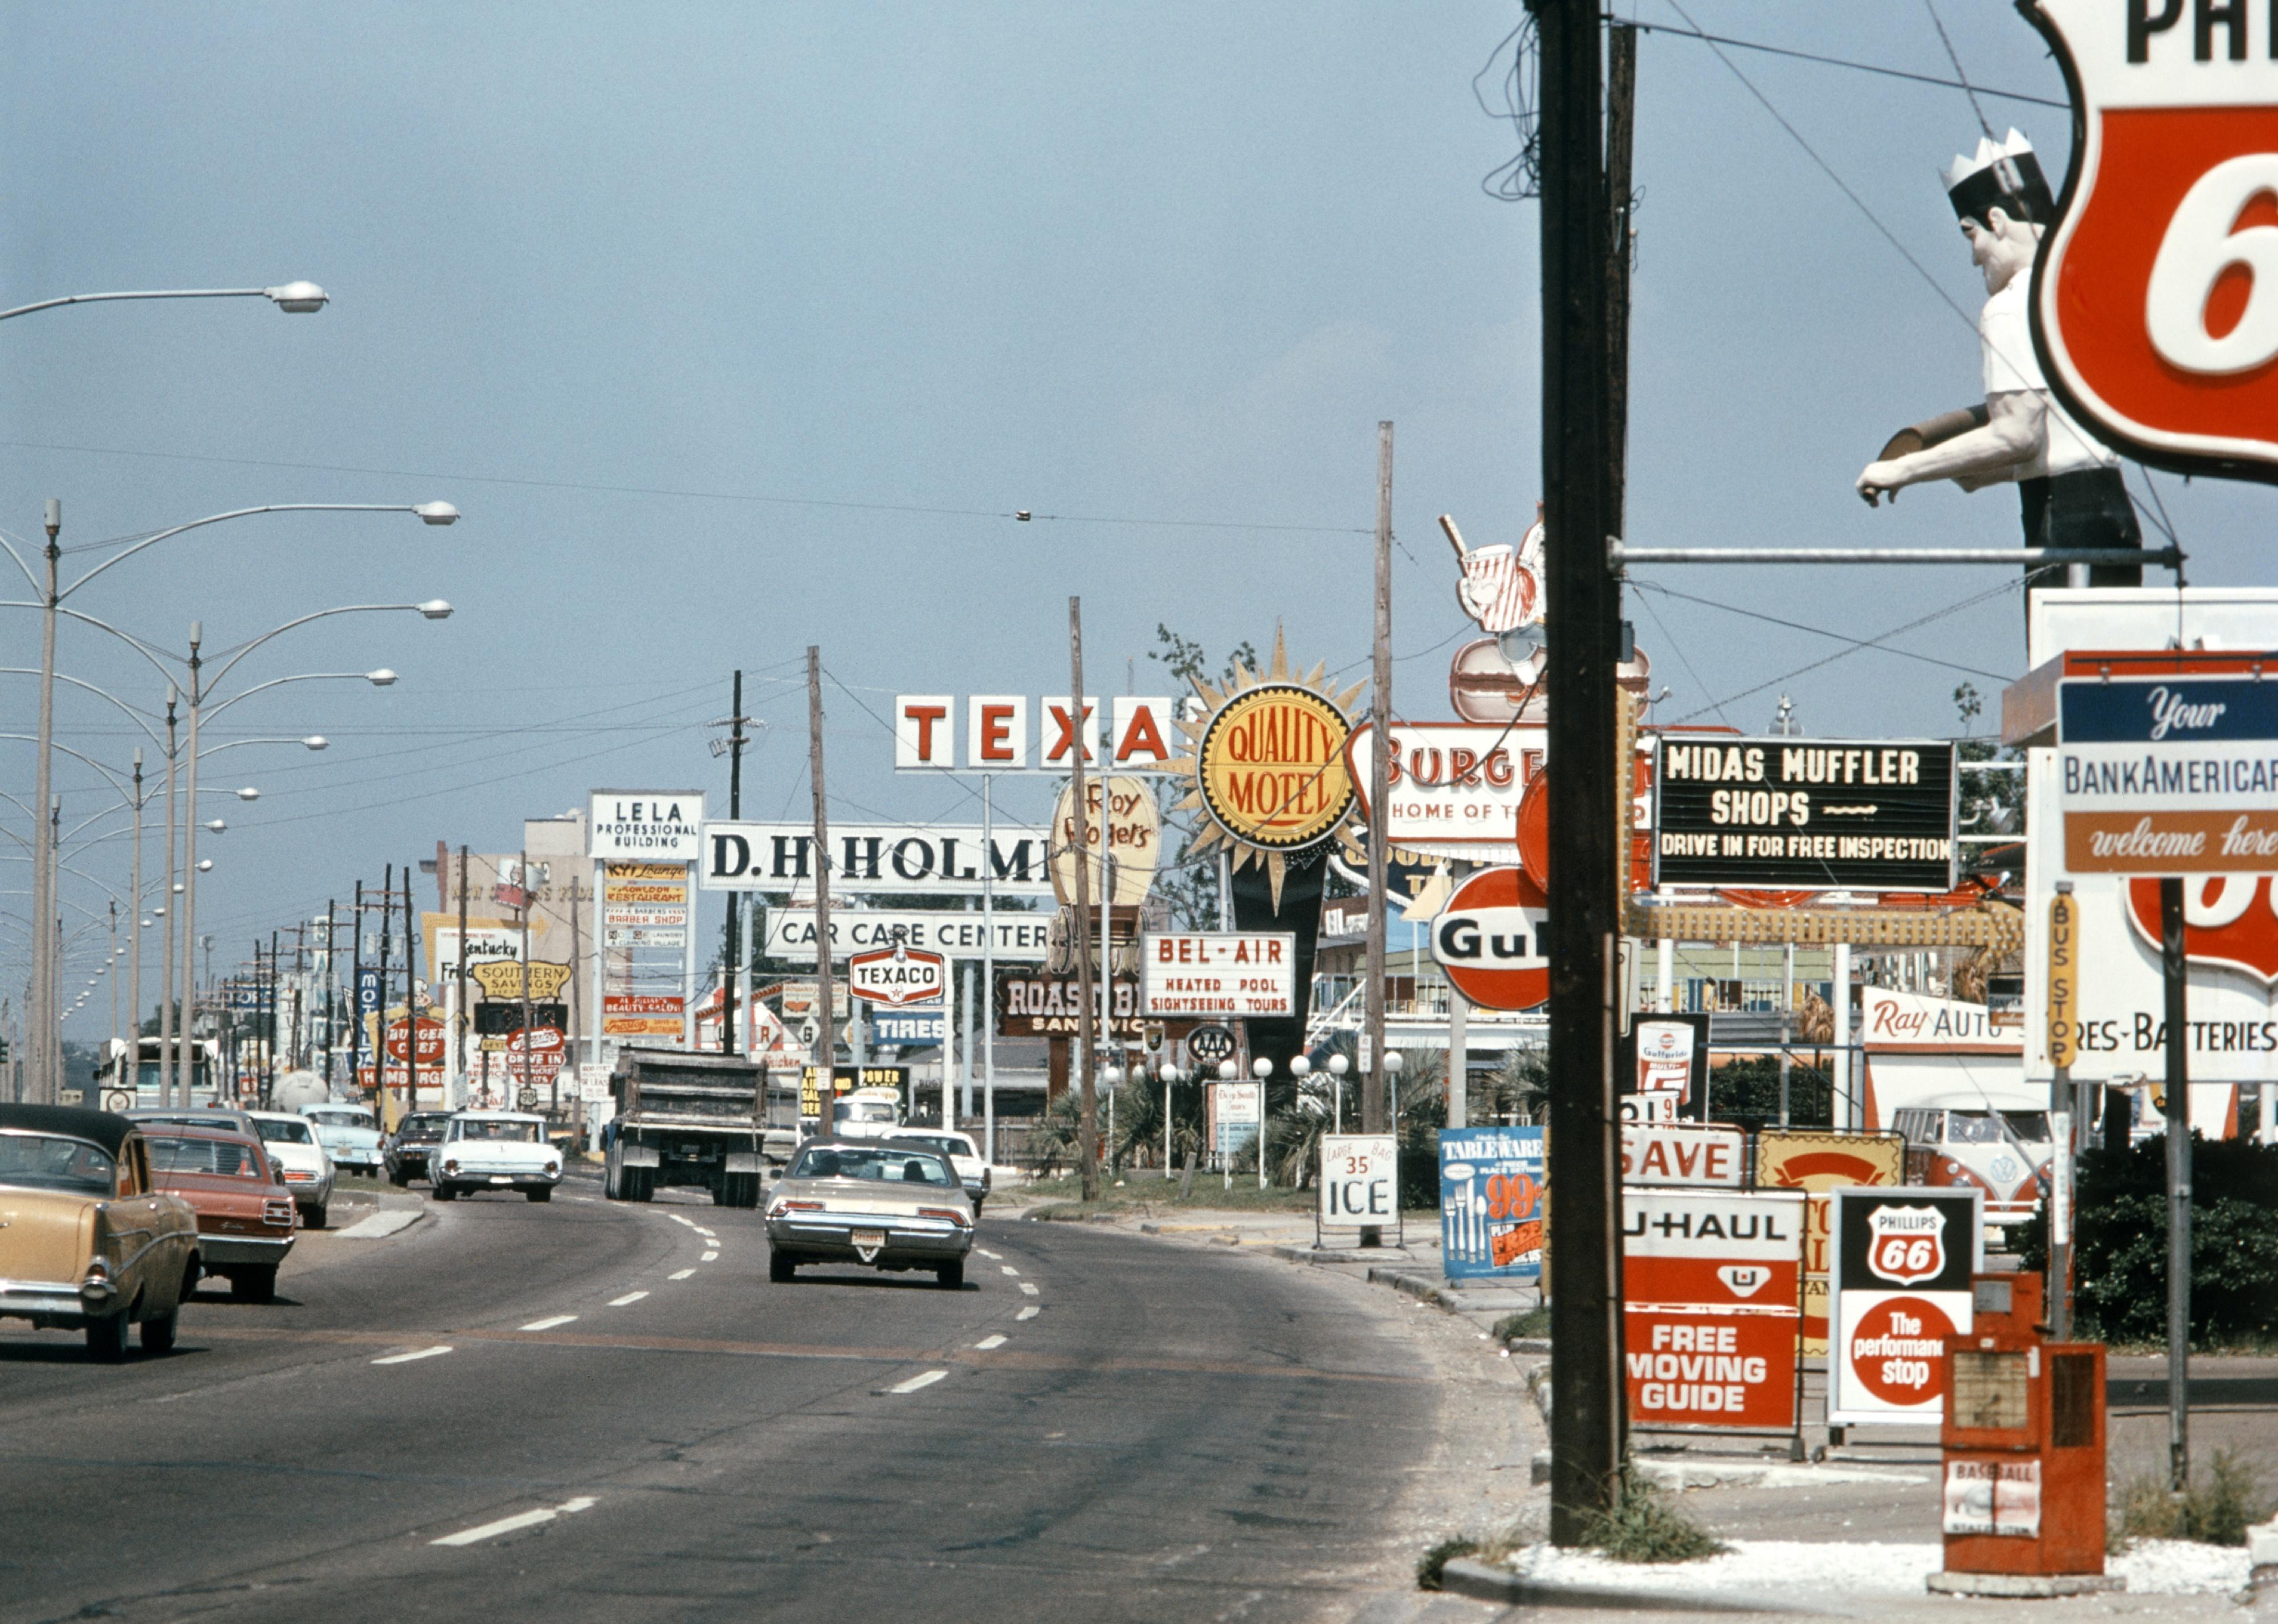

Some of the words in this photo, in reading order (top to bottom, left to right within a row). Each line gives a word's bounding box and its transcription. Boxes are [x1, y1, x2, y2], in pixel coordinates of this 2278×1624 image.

[2147, 686, 2226, 740] Your
[1229, 705, 1333, 762] QUALITY
[1667, 746, 1764, 782] MIDAS
[1782, 750, 1920, 785] MUFFLER
[1086, 784, 1140, 818] Roy
[1228, 772, 1331, 814] MOTEL
[1392, 803, 1453, 818] HOME
[1464, 804, 1492, 819] OF
[1711, 790, 1810, 826] SHOPS
[597, 823, 697, 835] PROFESSIONAL
[2090, 817, 2206, 857] welcome
[2220, 815, 2278, 856] here
[615, 837, 678, 848] BUILDING
[1661, 833, 1717, 856] DRIVE
[1722, 834, 1745, 856] IN
[1747, 834, 1785, 857] FOR
[1788, 835, 1836, 859] FREE
[1839, 835, 1951, 861] INSPECTION
[608, 893, 682, 902] RESTAURANT
[609, 915, 649, 925] BARBER
[654, 915, 683, 924] SHOP
[782, 923, 838, 944] CAR
[851, 923, 924, 946] CARE
[2054, 904, 2069, 966] BUS
[858, 966, 935, 984] TEXACO
[1166, 978, 1221, 992] HEATED
[1240, 978, 1278, 993] POOL
[606, 1003, 644, 1012] BEAUTY
[1151, 998, 1235, 1010] SIGHTSEEING
[1246, 998, 1287, 1011] TOURS
[876, 1019, 944, 1039] TIRES
[1873, 999, 1929, 1038] Ray
[2053, 978, 2069, 1061] STOP
[1199, 1033, 1226, 1058] AAA
[1644, 1047, 1688, 1059] Gulfpride
[548, 1054, 561, 1064] IN
[522, 1092, 534, 1103] 90
[1664, 1098, 1672, 1119] 9
[1326, 1143, 1353, 1162] LARGE
[1371, 1141, 1392, 1161] BAG
[1442, 1139, 1543, 1161] TABLEWARE
[1330, 1178, 1389, 1215] ICE
[1879, 1215, 1937, 1231] PHILLIPS
[1881, 1240, 1931, 1269] 66
[1889, 1312, 1921, 1335] The
[1653, 1325, 1737, 1353] FREE
[1627, 1354, 1766, 1384] MOVING
[1881, 1357, 1930, 1390] stop
[1641, 1385, 1745, 1412] GUIDE
